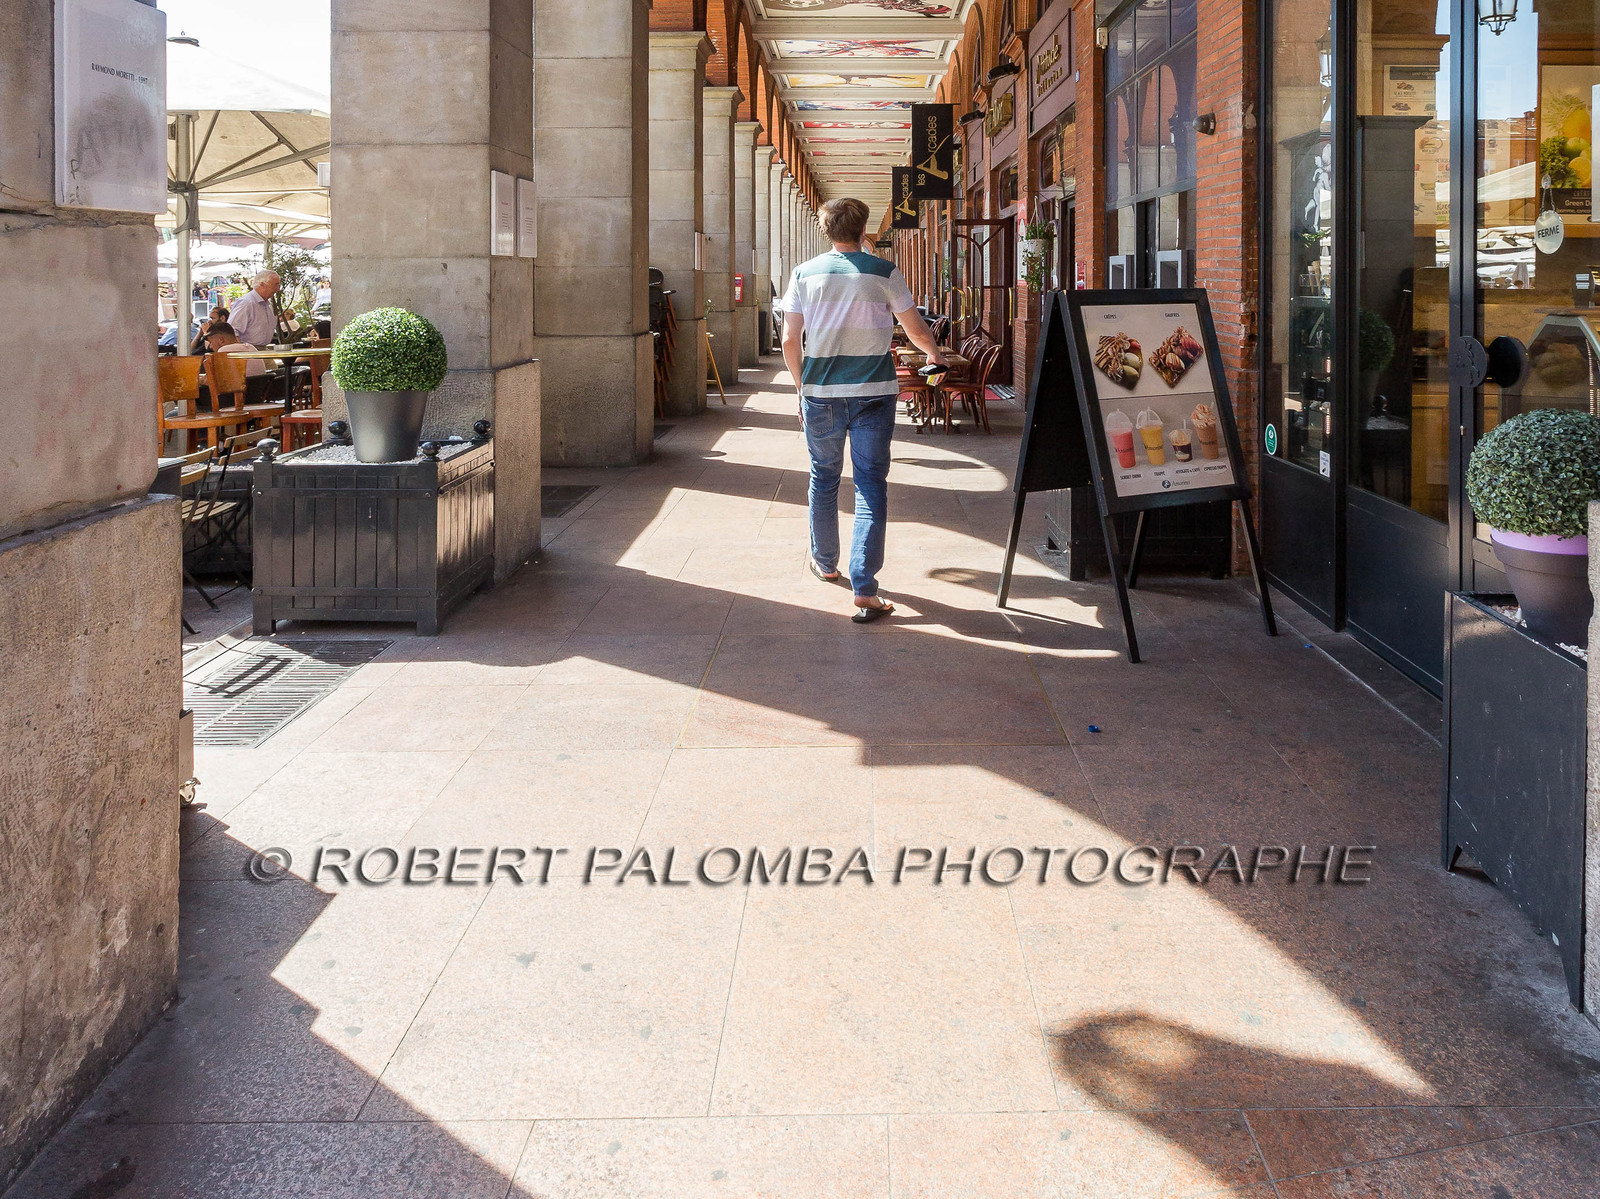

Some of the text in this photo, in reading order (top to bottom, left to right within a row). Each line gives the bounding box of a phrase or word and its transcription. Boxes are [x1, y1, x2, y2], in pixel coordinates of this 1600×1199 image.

[115, 69, 135, 82] MORETTI
[915, 114, 951, 187] les Arcades
[1564, 199, 1584, 207] Green
